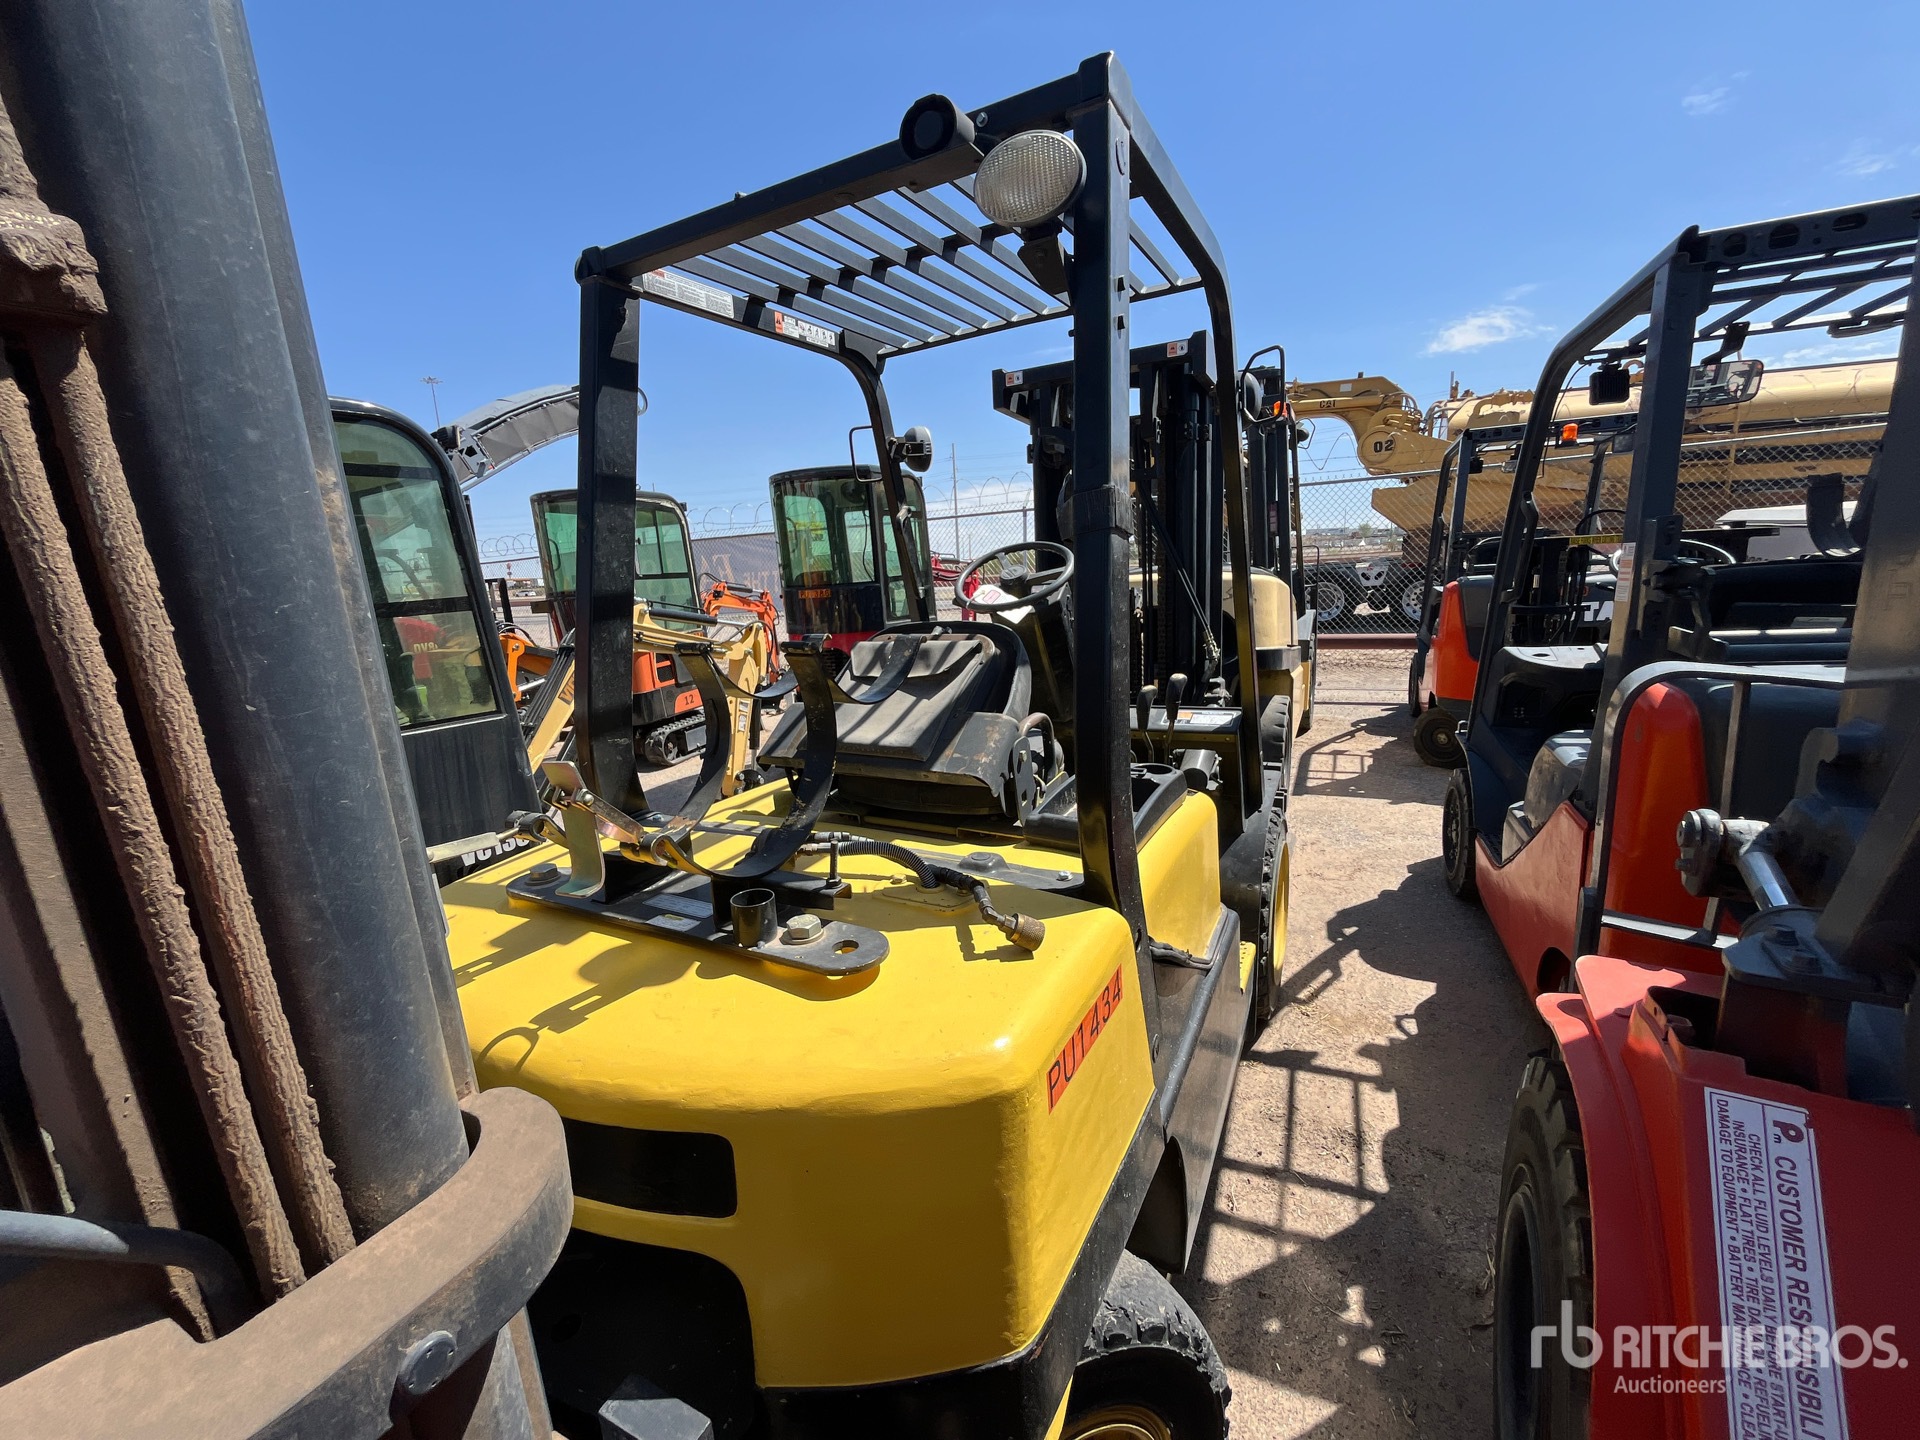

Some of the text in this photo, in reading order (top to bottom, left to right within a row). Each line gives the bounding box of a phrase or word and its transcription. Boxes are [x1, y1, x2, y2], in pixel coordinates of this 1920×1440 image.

[1373, 439, 1394, 453] 02
[684, 694, 695, 706] 12
[1716, 1099, 1732, 1146] DAMAGE
[1720, 1148, 1733, 1163] TO
[1732, 1120, 1750, 1185] INSURANCE
[1721, 1165, 1739, 1234] EQUIPMENT
[1738, 1195, 1752, 1228] FLAT
[1741, 1229, 1757, 1263] TIRES
[1728, 1244, 1745, 1301] BATTERY
[1745, 1277, 1760, 1305] TIRE
[1748, 1133, 1788, 1440] CHECK ALL FLUID LEVELS DAILY BEFORE START-U
[1774, 1155, 1826, 1440] CUSTOMER RESPONSIBILI
[1747, 1305, 1766, 1361] DAMAGE
